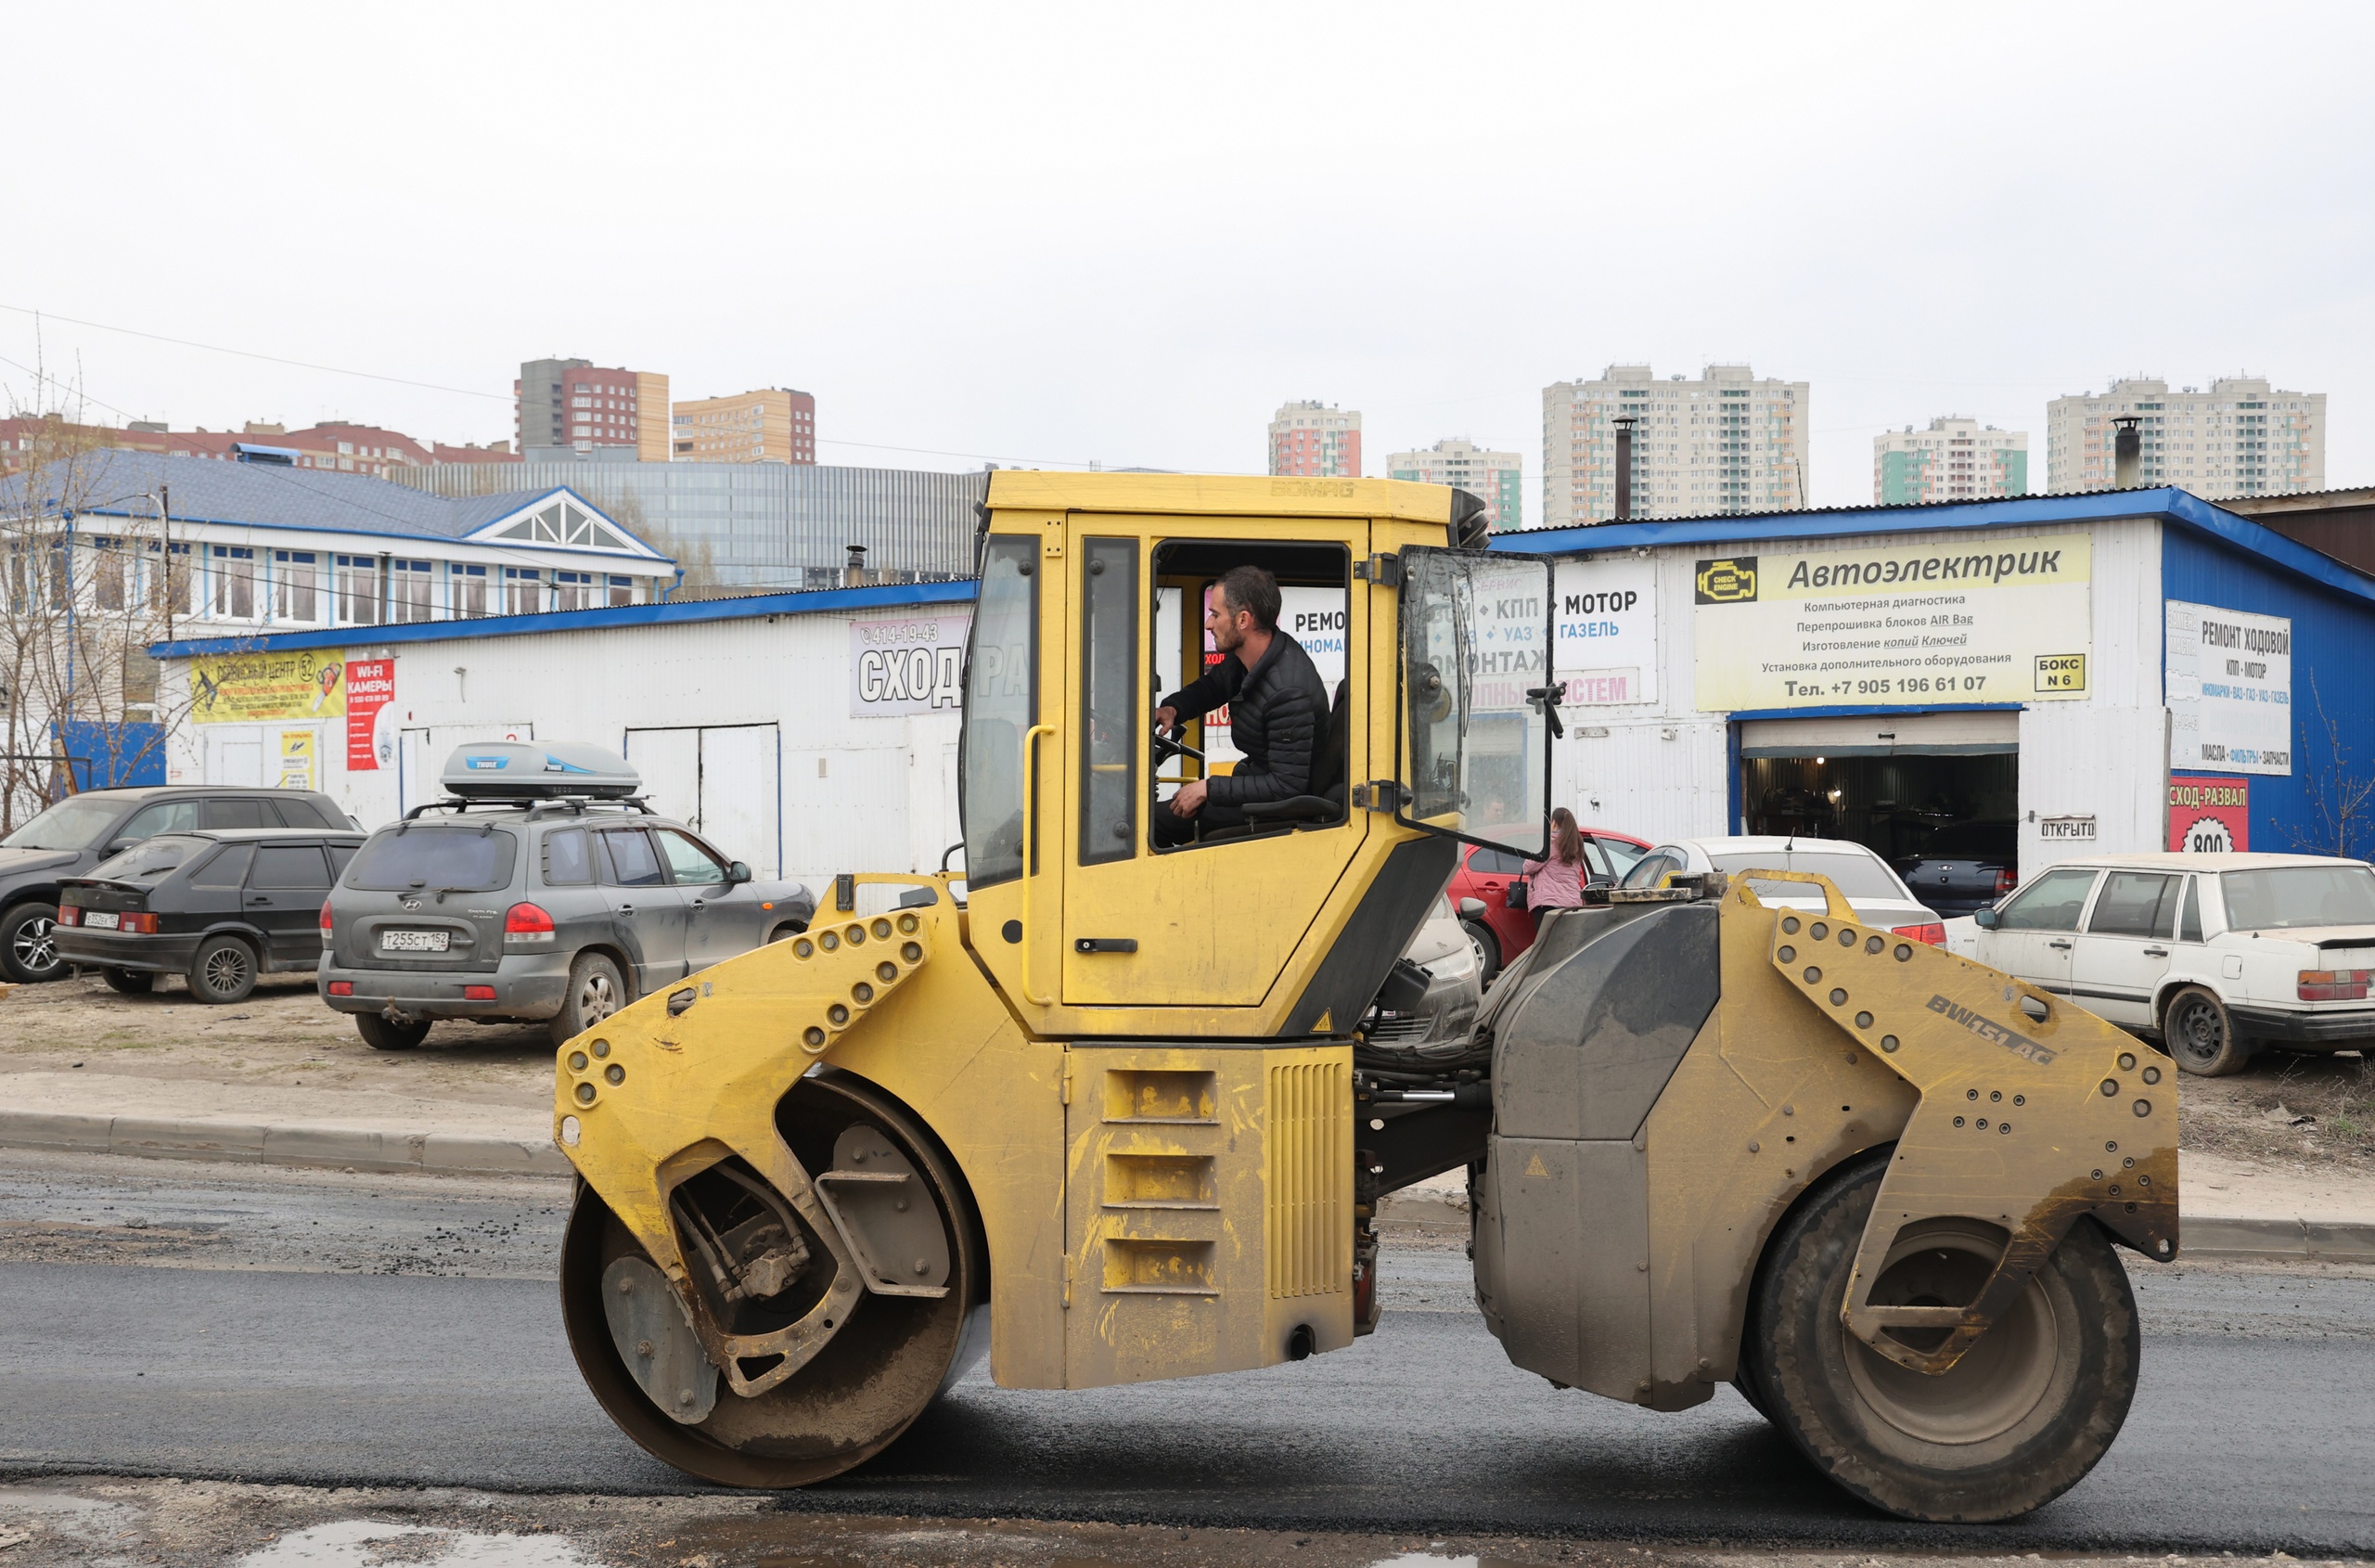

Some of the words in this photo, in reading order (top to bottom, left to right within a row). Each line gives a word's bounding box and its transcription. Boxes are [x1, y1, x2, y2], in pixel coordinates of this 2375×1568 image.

[1271, 481, 1354, 497] BOMAG
[1788, 550, 2060, 589] Автоэлектрик
[1714, 576, 1737, 585] CHECK
[1714, 583, 1739, 591] ENGINE
[1496, 598, 1538, 619] КПП
[1565, 591, 1637, 615] МОТОР
[1804, 599, 1890, 613] Компьютерная
[1893, 595, 1965, 609] диагностика
[1296, 611, 1345, 632] РЕМО
[1797, 618, 1882, 632] Перепрошивка
[1885, 615, 1927, 628] блоков
[1931, 614, 1949, 625] AIR
[1952, 613, 1973, 626] Bag
[872, 623, 939, 644] 414-19-43
[1504, 627, 1533, 642] УАЗ
[1560, 622, 1619, 638] ГАЗЕЛЬ
[1803, 636, 1881, 651] Изготовление
[1884, 635, 1919, 649] копий
[1921, 633, 1967, 646] Ключей
[2202, 621, 2241, 649] РЕМОНТ
[2244, 628, 2289, 656] ХОДОВОЙ
[2169, 635, 2197, 656] МАСЛА
[269, 661, 295, 680] ЦЕНТР
[302, 660, 312, 678] 52
[357, 665, 383, 678] WI-FI
[1762, 660, 1817, 674] Установка
[1820, 656, 1921, 671] дополнительного
[1924, 652, 2011, 667] оборудования
[2039, 659, 2080, 672] БОКС
[2227, 659, 2240, 675] КПП
[2244, 662, 2266, 679] МОТОР
[348, 679, 392, 694] КАМЕРЫ
[1785, 680, 1825, 697] Тел.
[1831, 680, 1852, 694] +7
[1857, 679, 1891, 694] 905
[1897, 678, 1930, 693] 196
[1935, 677, 1957, 691] 61
[1963, 675, 1986, 690] 07
[2048, 675, 2059, 686] N
[2062, 675, 2071, 686] 6
[2202, 683, 2230, 699] ИНОМАРКИ
[2232, 687, 2243, 700] ВАЗ
[2245, 688, 2256, 700] ГАЗ
[2258, 688, 2269, 702] УАЗ
[2270, 690, 2289, 704] ГАЗЕЛЬ
[2202, 744, 2226, 762] МАСЛА
[2229, 748, 2259, 765] ФИЛЬТРЫ
[2262, 751, 2289, 765] ЗАПЧАСТИ
[476, 761, 497, 769] THULE
[546, 764, 562, 772] THULE
[2169, 786, 2246, 810] СХОД-РАЗВАЛ
[2041, 822, 2095, 837] ОТКРЫТО
[2193, 833, 2223, 853] 800
[386, 932, 429, 946] Т255СТ
[430, 932, 447, 944] 152
[2010, 1041, 2054, 1066] AC
